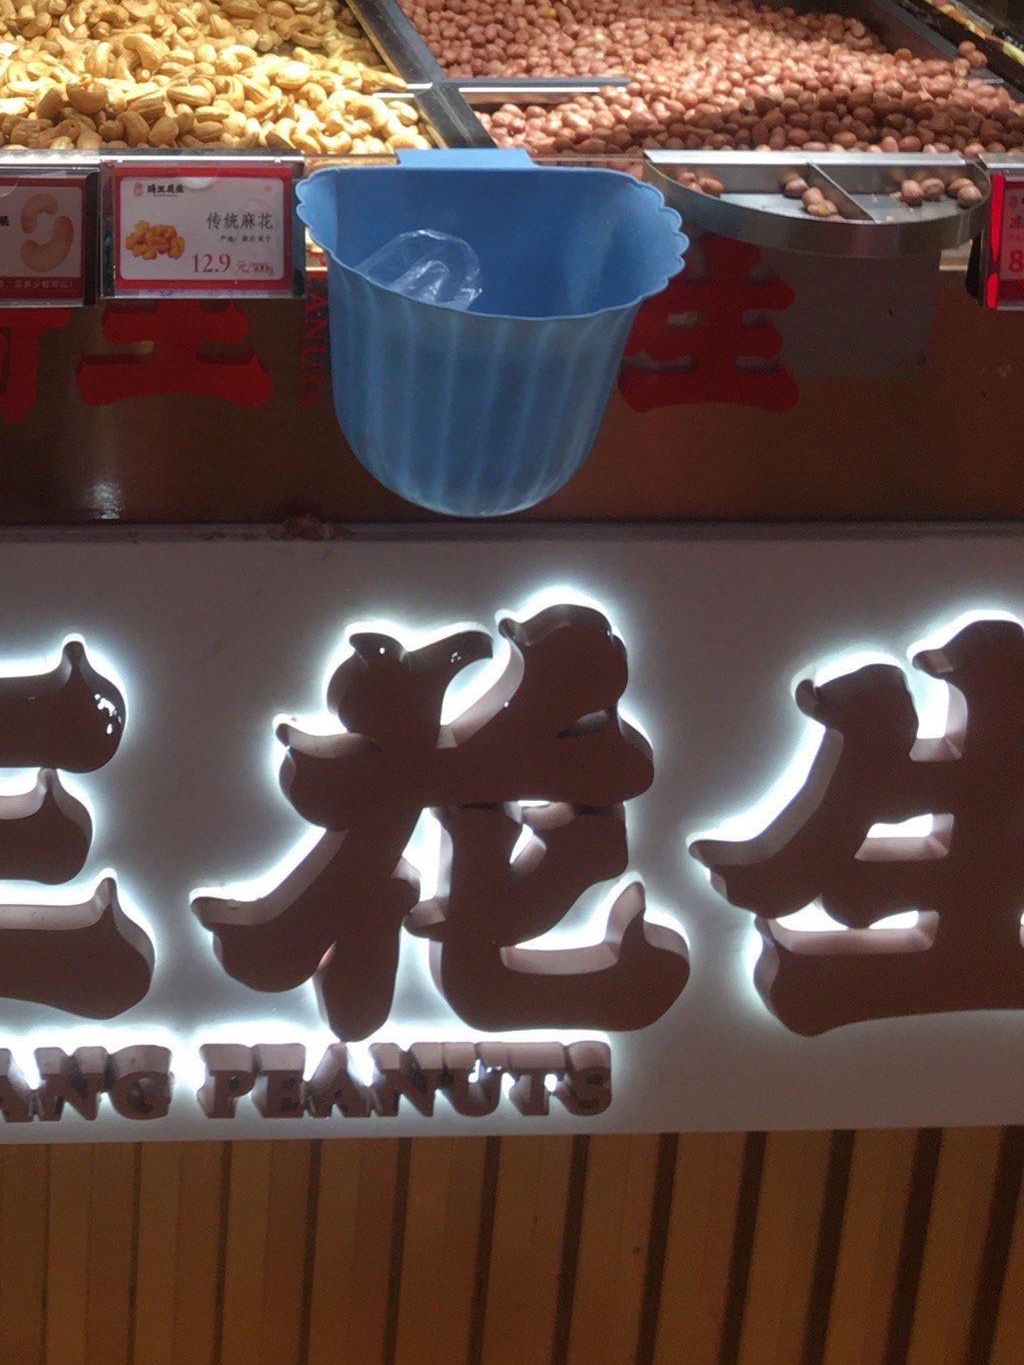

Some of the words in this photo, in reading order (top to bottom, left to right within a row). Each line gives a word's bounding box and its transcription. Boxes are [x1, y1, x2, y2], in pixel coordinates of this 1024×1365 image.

[206, 212, 274, 230] 传统麻花
[192, 253, 231, 274] 12.9
[198, 1042, 612, 1119] PEANUTS
